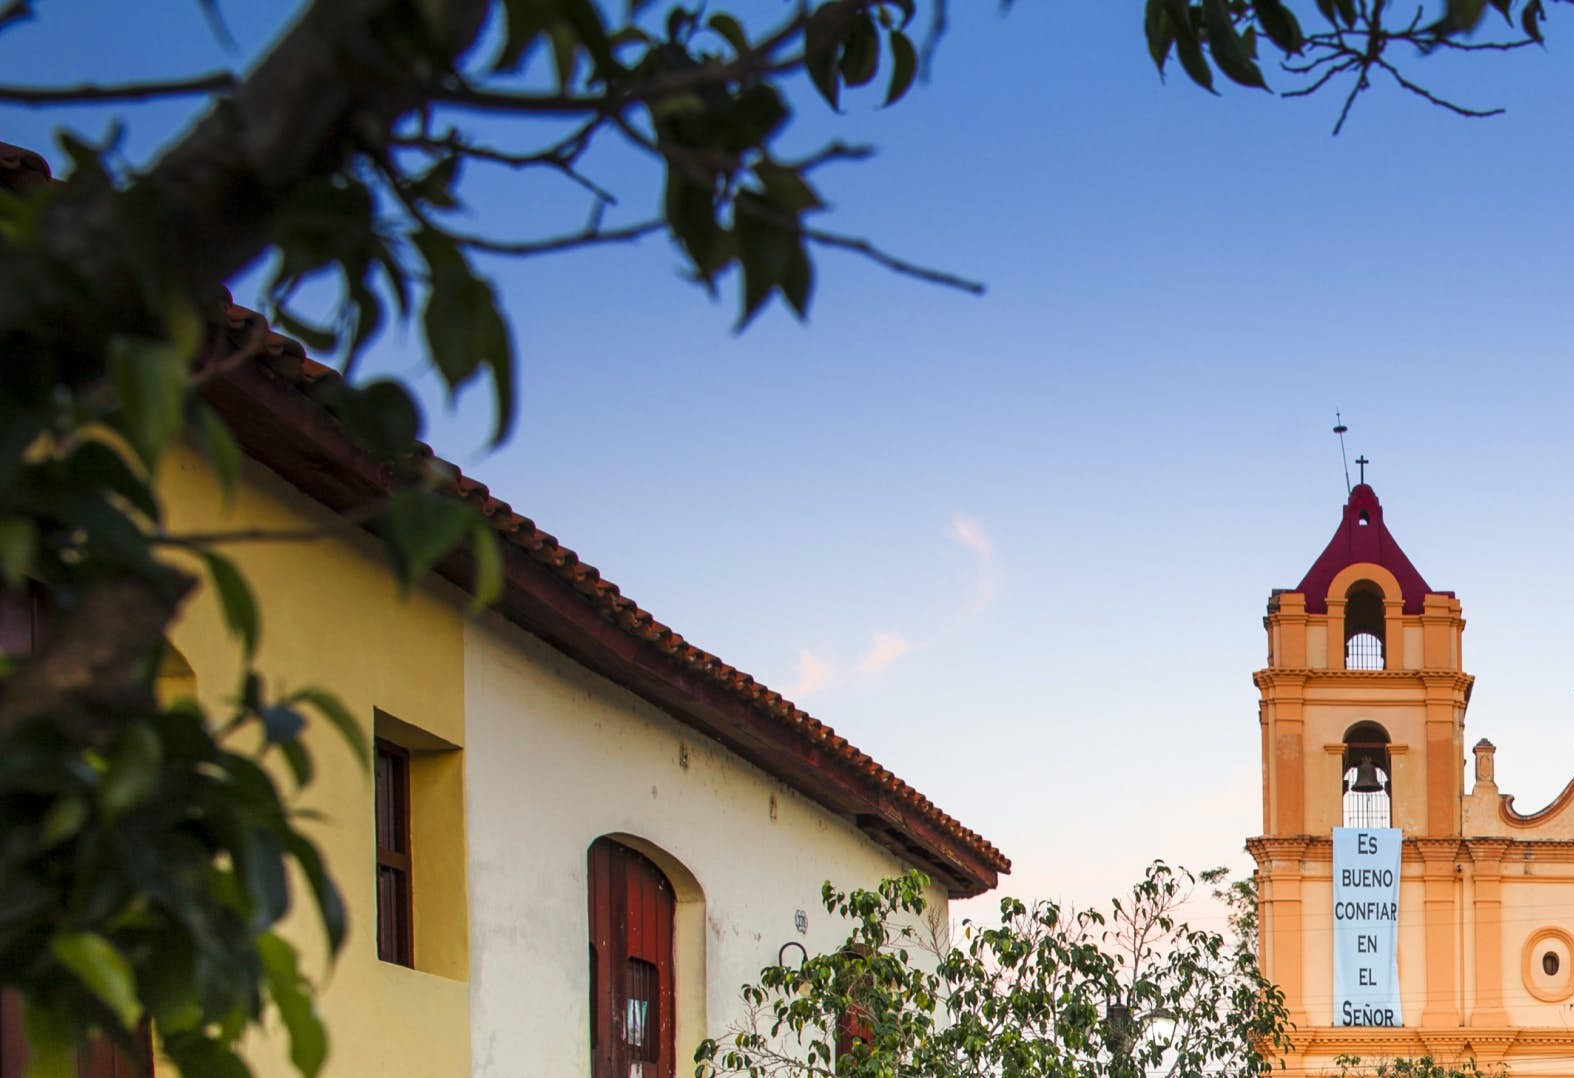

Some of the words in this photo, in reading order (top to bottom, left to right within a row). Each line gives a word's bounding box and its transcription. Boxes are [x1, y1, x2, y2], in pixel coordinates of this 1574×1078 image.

[1357, 833, 1378, 855] ES
[1342, 869, 1393, 888] BUENO
[1335, 902, 1397, 921] CONFIAR
[1357, 935, 1377, 953] EN
[1359, 967, 1377, 986] EL
[1342, 1000, 1394, 1026] SEÑOR
